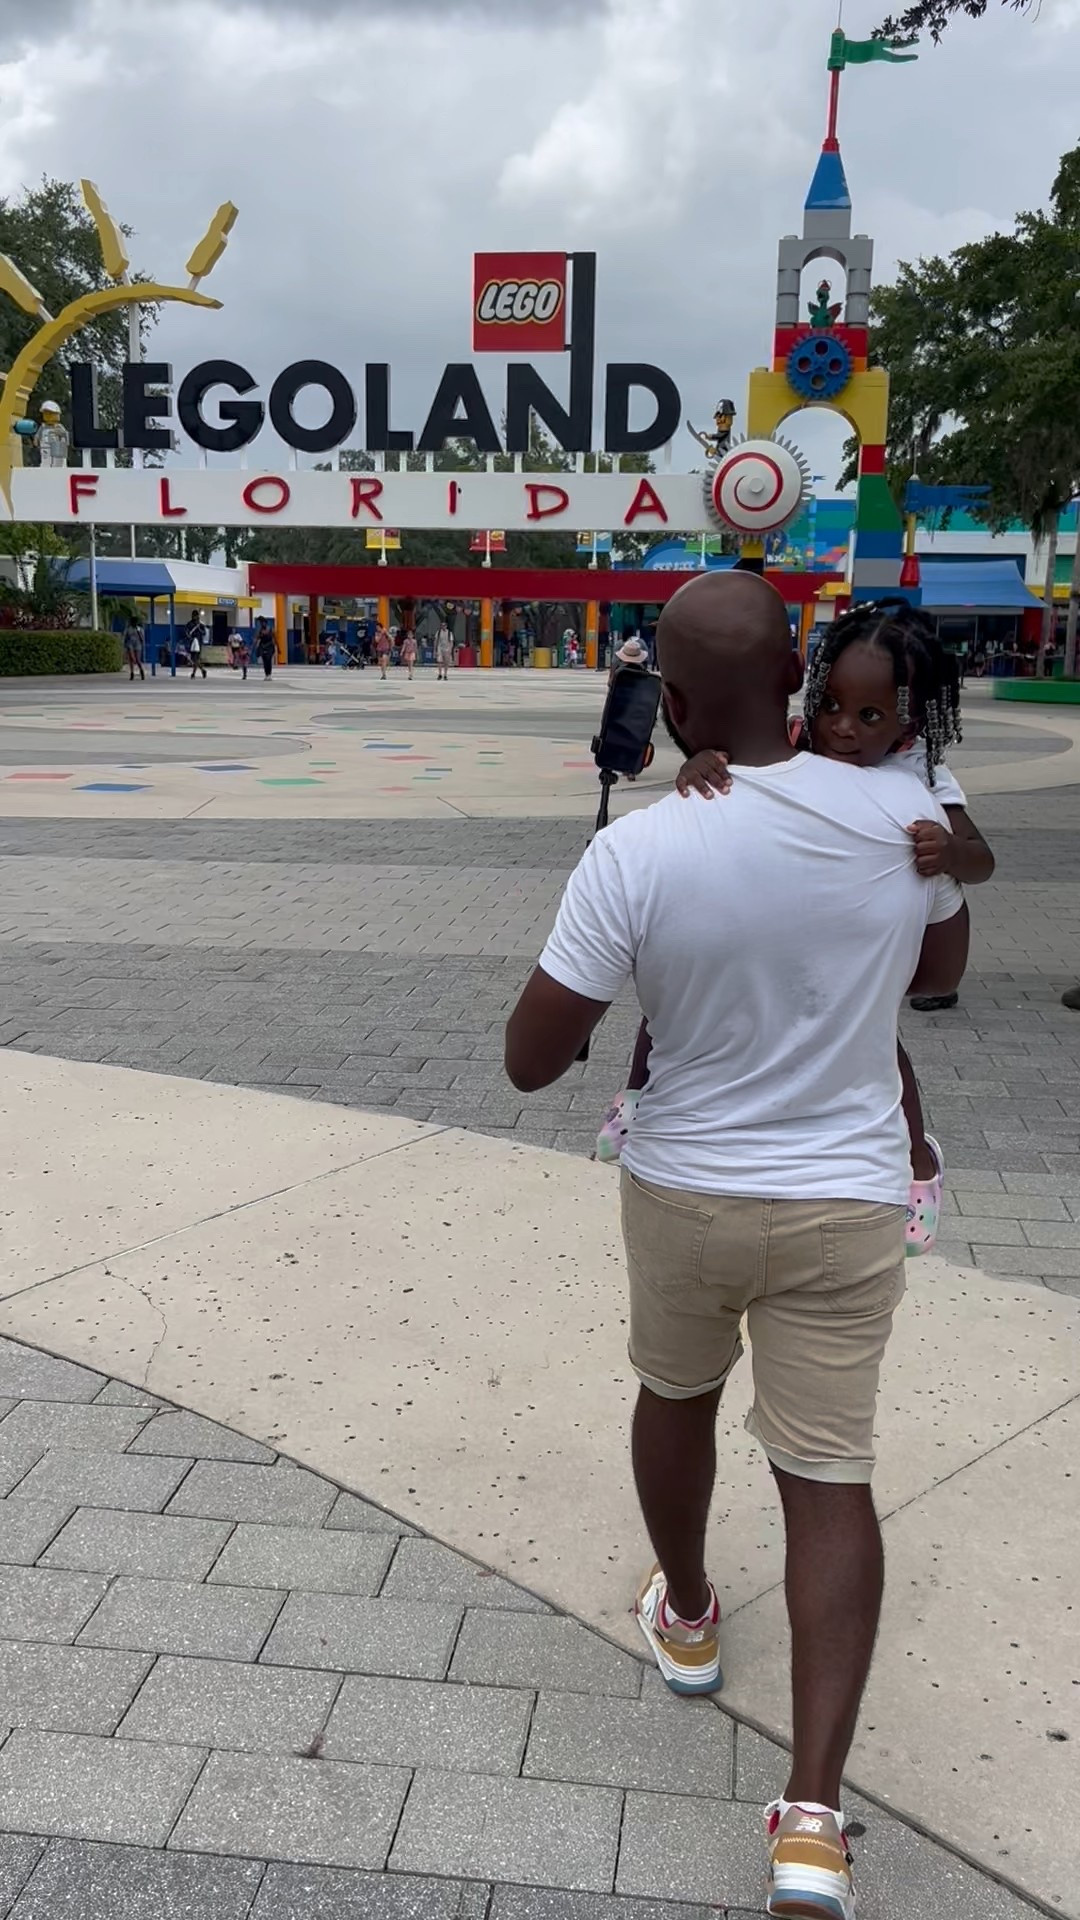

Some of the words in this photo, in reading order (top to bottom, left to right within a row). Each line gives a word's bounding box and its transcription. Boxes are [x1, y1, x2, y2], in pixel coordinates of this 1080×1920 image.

[479, 282, 560, 320] LEGO
[71, 252, 681, 453] LEGOLAND
[70, 475, 668, 525] FLORIDA
